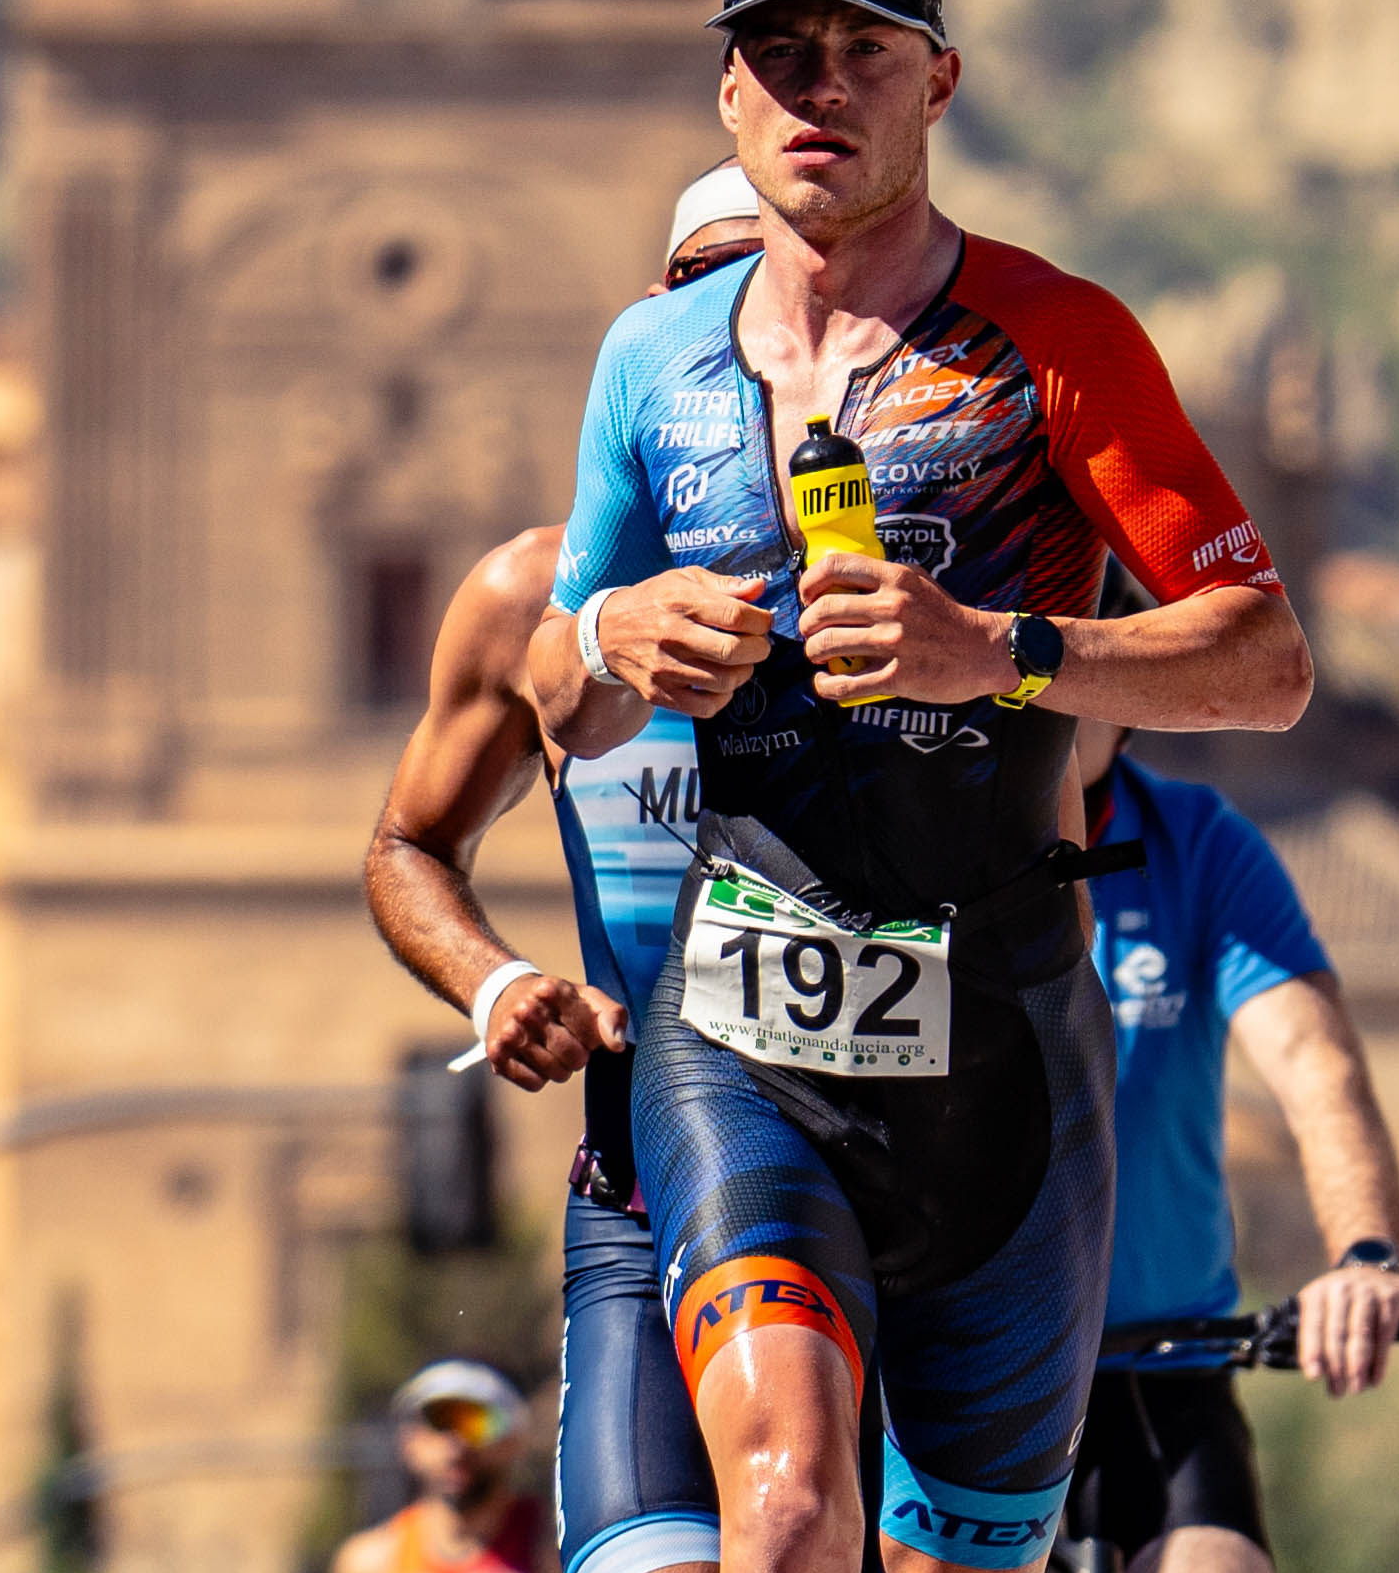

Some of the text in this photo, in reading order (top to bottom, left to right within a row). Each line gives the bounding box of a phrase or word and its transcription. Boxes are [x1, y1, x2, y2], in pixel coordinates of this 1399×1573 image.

[657, 422, 742, 448] TRILIFE
[1192, 518, 1258, 572] INFINIT
[718, 728, 802, 757] Walzym
[852, 706, 953, 736] INFINIT
[719, 926, 922, 1038] 192
[709, 1020, 925, 1058] www.triatlonandalucia.org
[692, 1279, 841, 1354] ATEX
[892, 1499, 1056, 1548] ATEX
